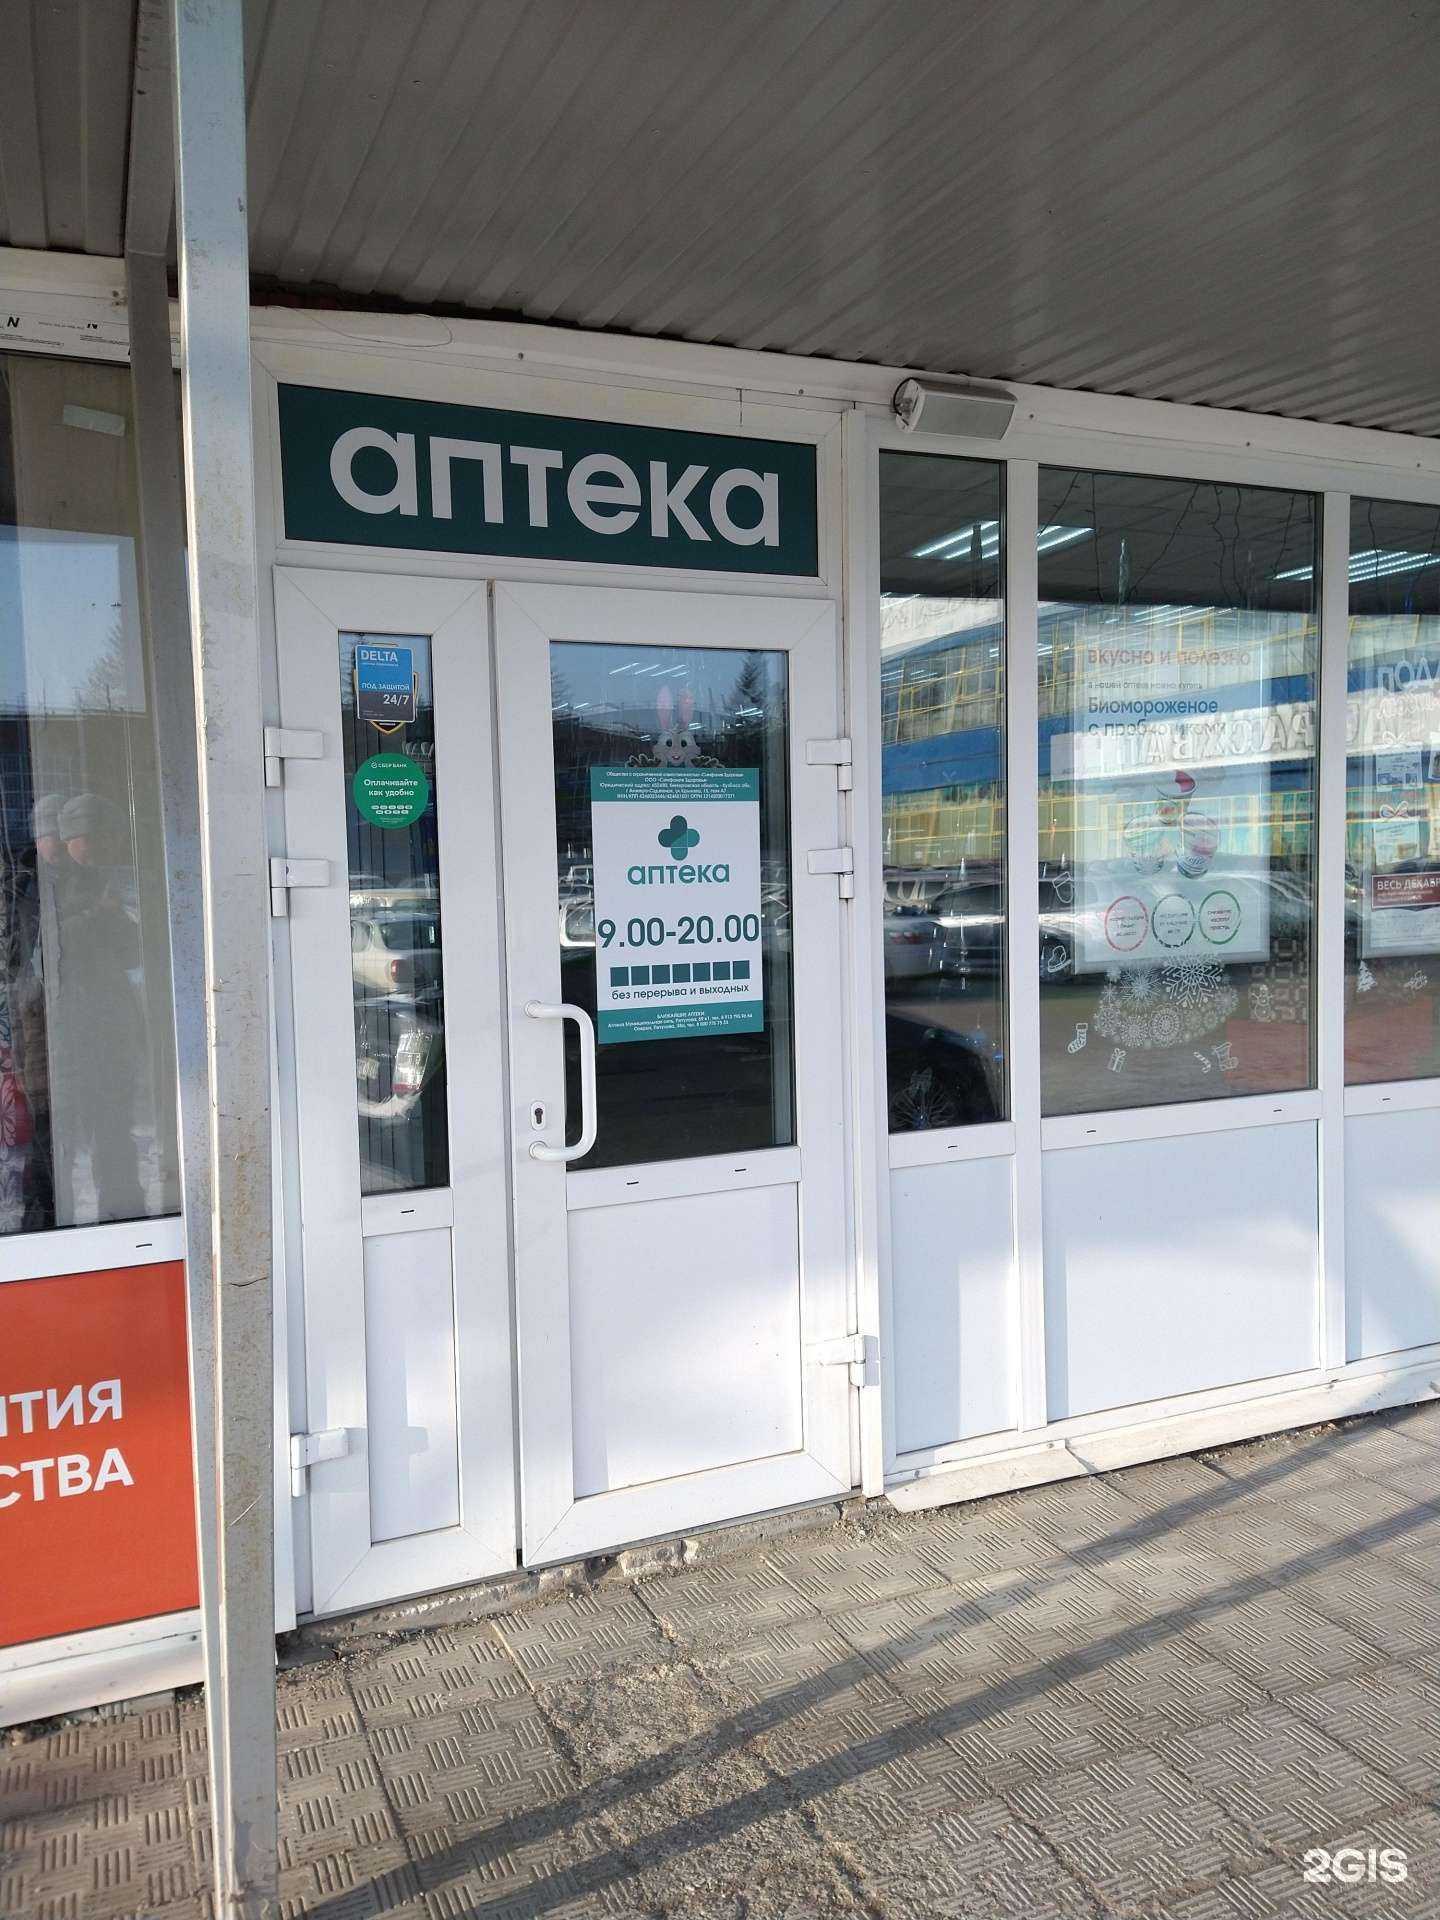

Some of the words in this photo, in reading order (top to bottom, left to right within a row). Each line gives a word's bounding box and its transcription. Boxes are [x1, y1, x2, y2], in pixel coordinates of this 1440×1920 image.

[329, 426, 780, 547] аптека
[360, 650, 398, 662] DELTA
[361, 682, 377, 691] ПОД
[379, 682, 410, 691] ЗАЩИТОЙ
[383, 694, 410, 706] 24/7
[1088, 697, 1219, 716] Биомороженое
[1088, 723, 1099, 736] с
[363, 778, 418, 787] Оплачивайте
[369, 789, 384, 797] как
[385, 788, 415, 798] удобно
[627, 863, 730, 885] аптека
[1376, 880, 1402, 891] ВЕСЬ
[597, 913, 760, 948] 9.00-20.00
[611, 989, 631, 1001] без
[633, 987, 687, 1000] перерыва
[690, 986, 697, 995] и
[699, 983, 750, 996] выходных
